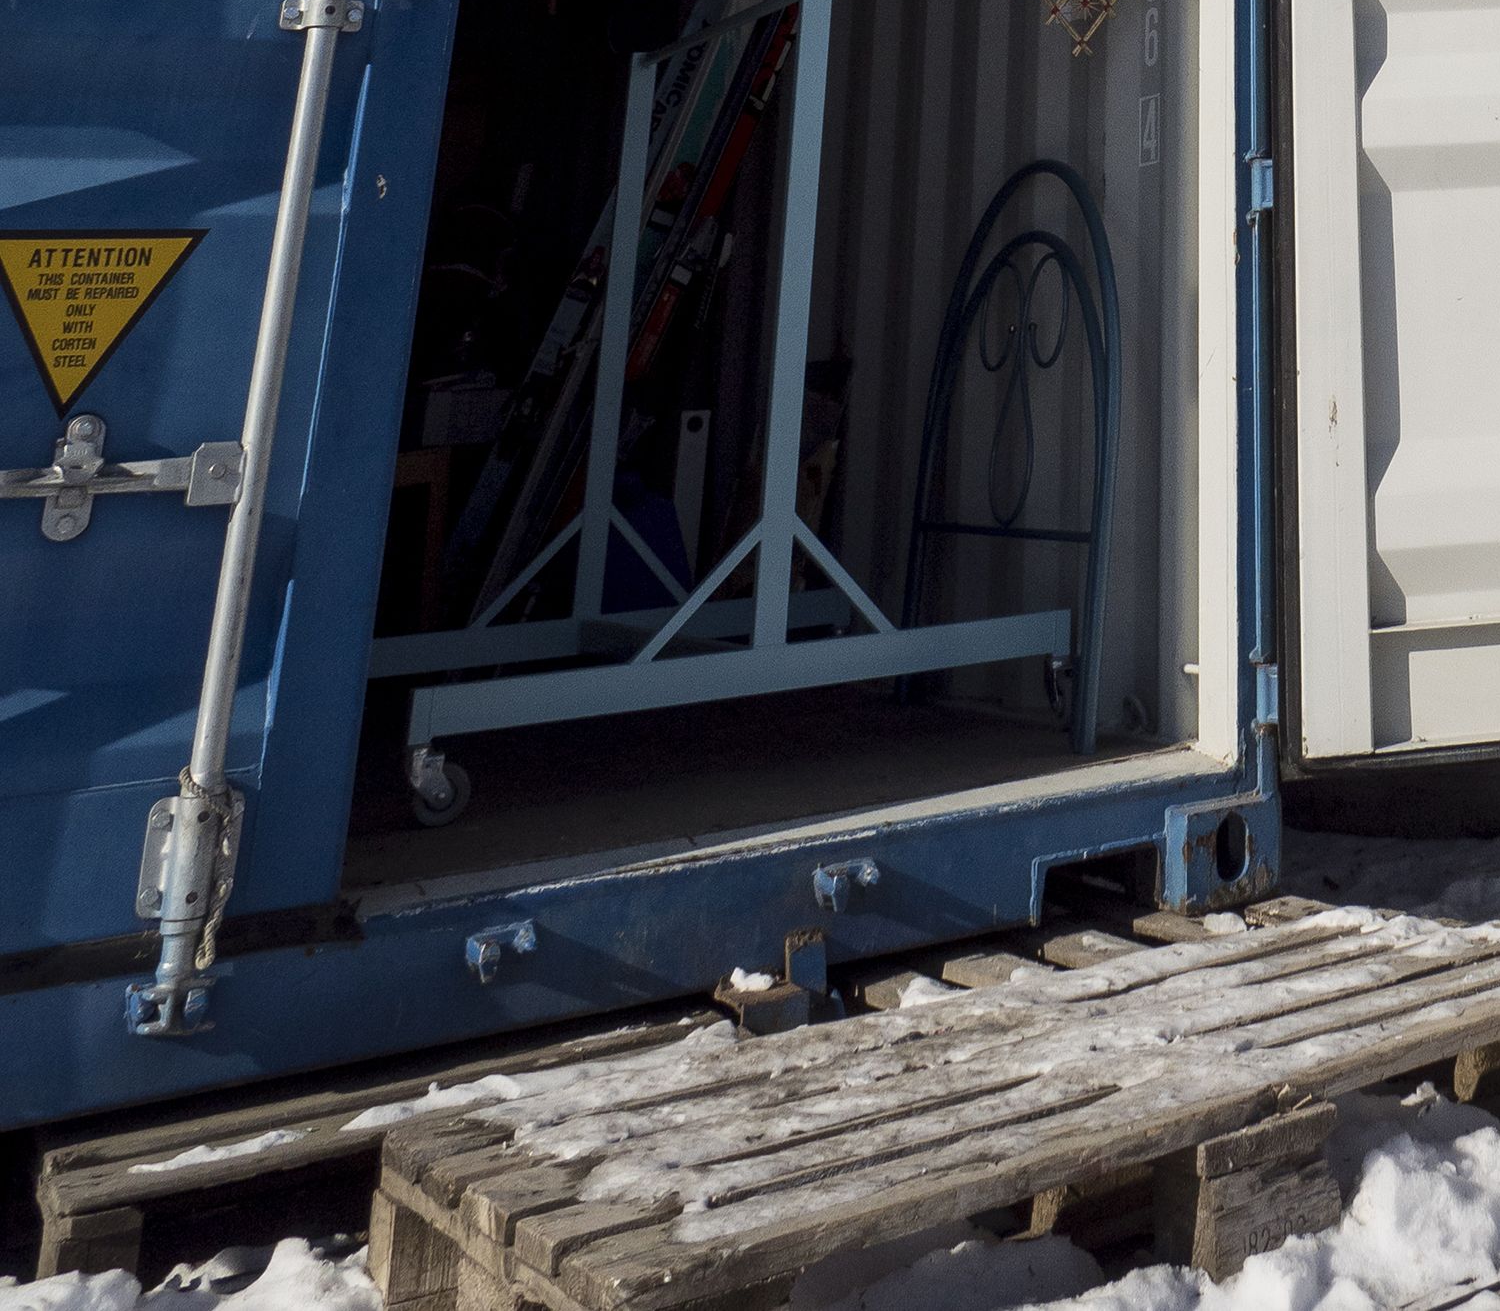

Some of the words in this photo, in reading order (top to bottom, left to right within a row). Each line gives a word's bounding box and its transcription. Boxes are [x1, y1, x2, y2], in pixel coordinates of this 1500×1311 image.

[28, 247, 153, 268] ATTENTION
[38, 273, 64, 285] THIS
[70, 272, 135, 285] CONTAINER
[27, 288, 59, 300] MUST
[65, 288, 79, 300] BE
[84, 287, 139, 299] REPAIRED
[66, 304, 96, 317] ONLY
[62, 321, 93, 334] WITH
[52, 337, 97, 351] CORTEN
[53, 355, 87, 368] STEEL
